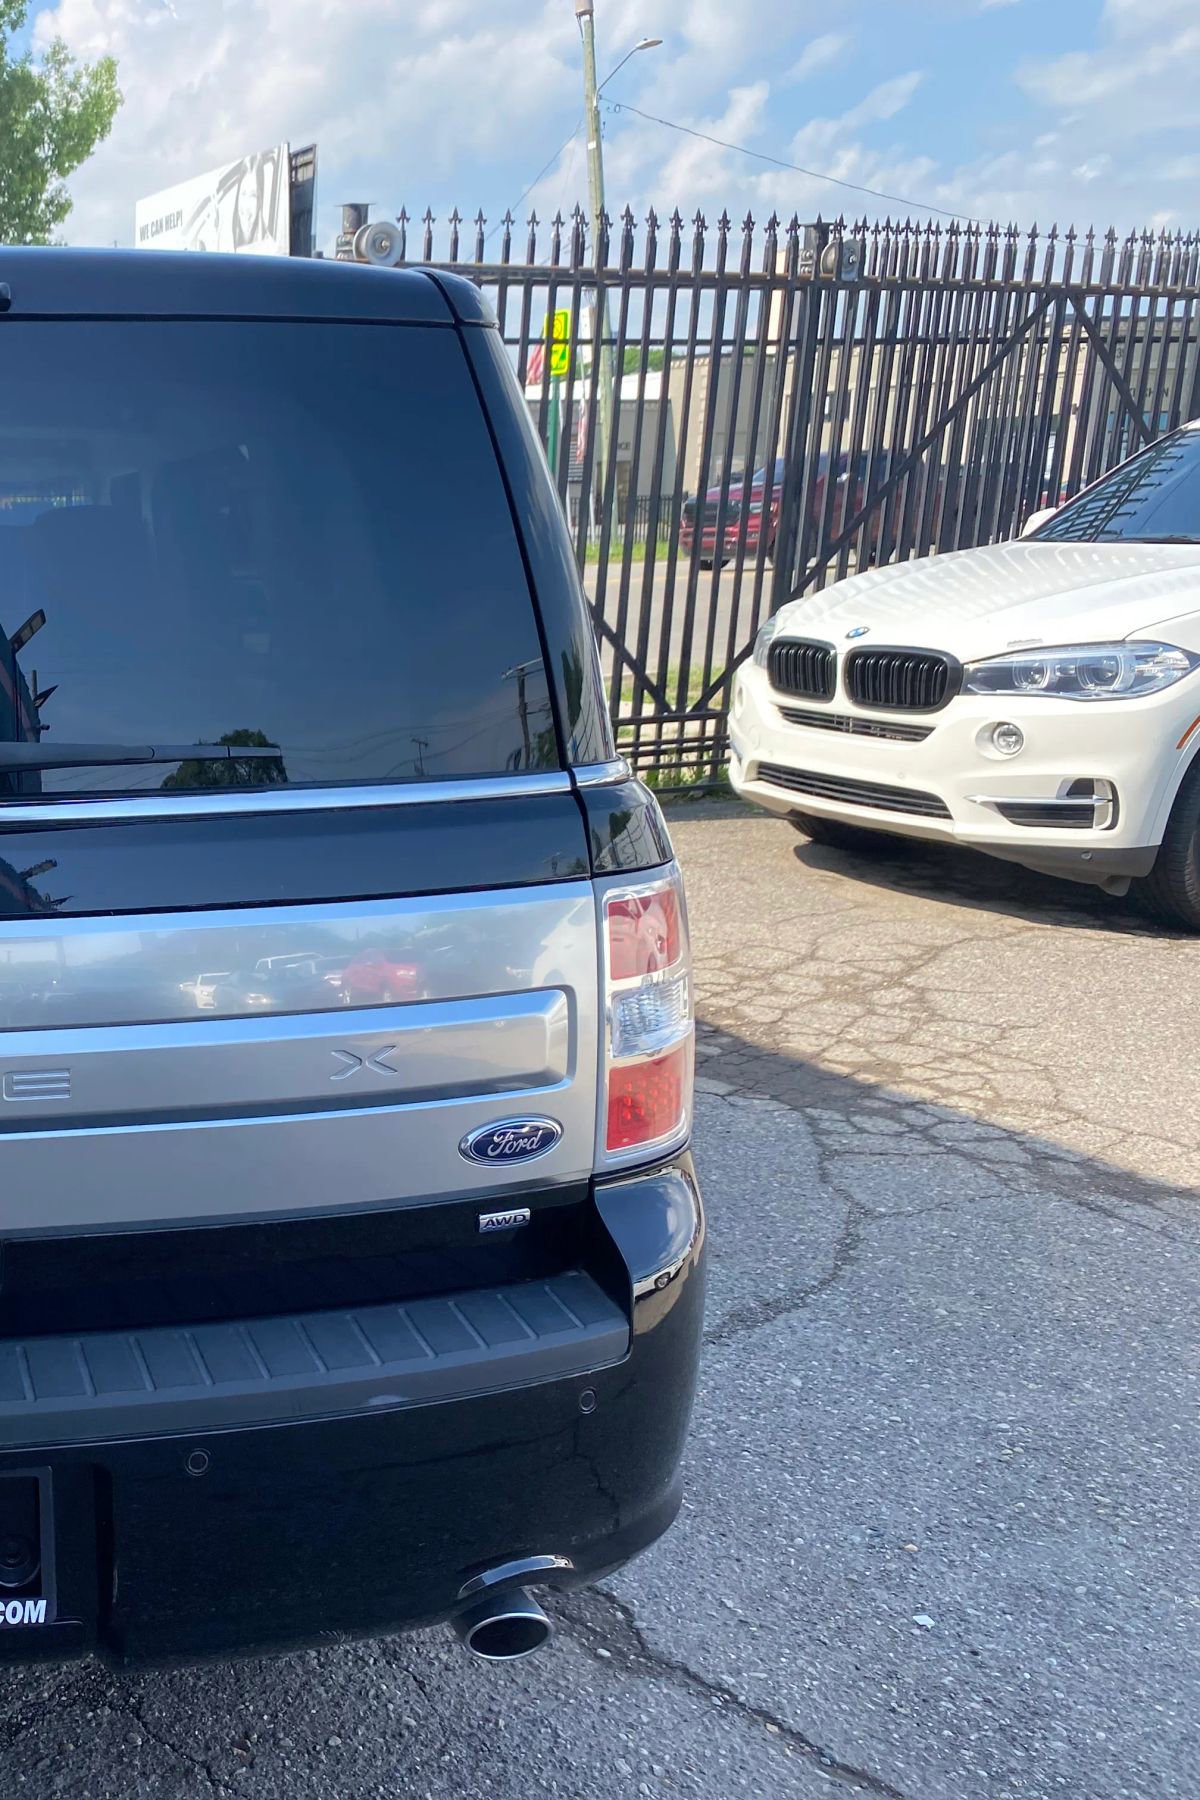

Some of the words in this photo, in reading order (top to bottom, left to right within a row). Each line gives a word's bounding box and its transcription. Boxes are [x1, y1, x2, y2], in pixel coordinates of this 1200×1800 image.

[140, 223, 149, 241] WE
[151, 217, 163, 237] CAN
[487, 1126, 543, 1156] Ford
[484, 1214, 528, 1229] AWD
